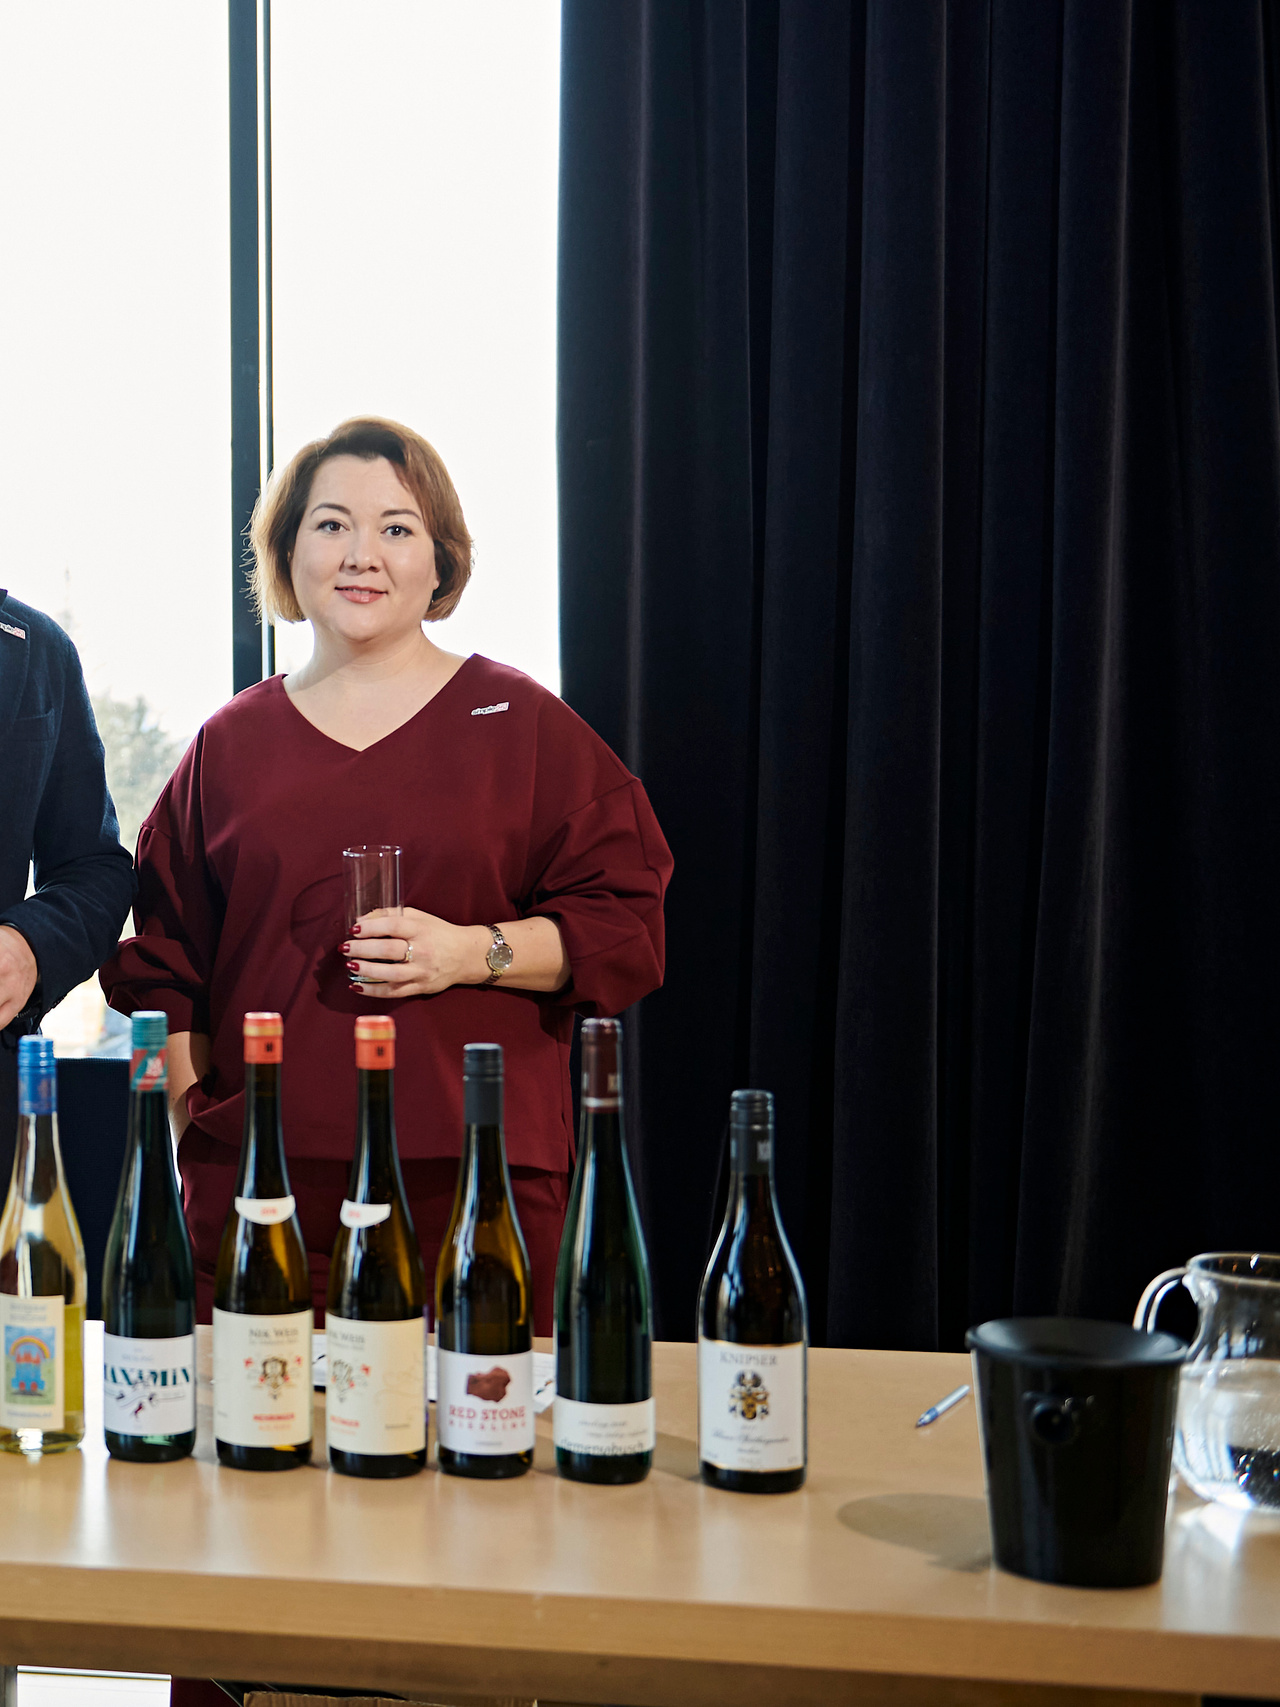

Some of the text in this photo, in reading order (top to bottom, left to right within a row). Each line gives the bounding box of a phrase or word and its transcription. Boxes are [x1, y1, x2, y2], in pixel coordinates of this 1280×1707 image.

[719, 1352, 778, 1366] KNIPSER
[449, 1404, 526, 1421] RED STONE
